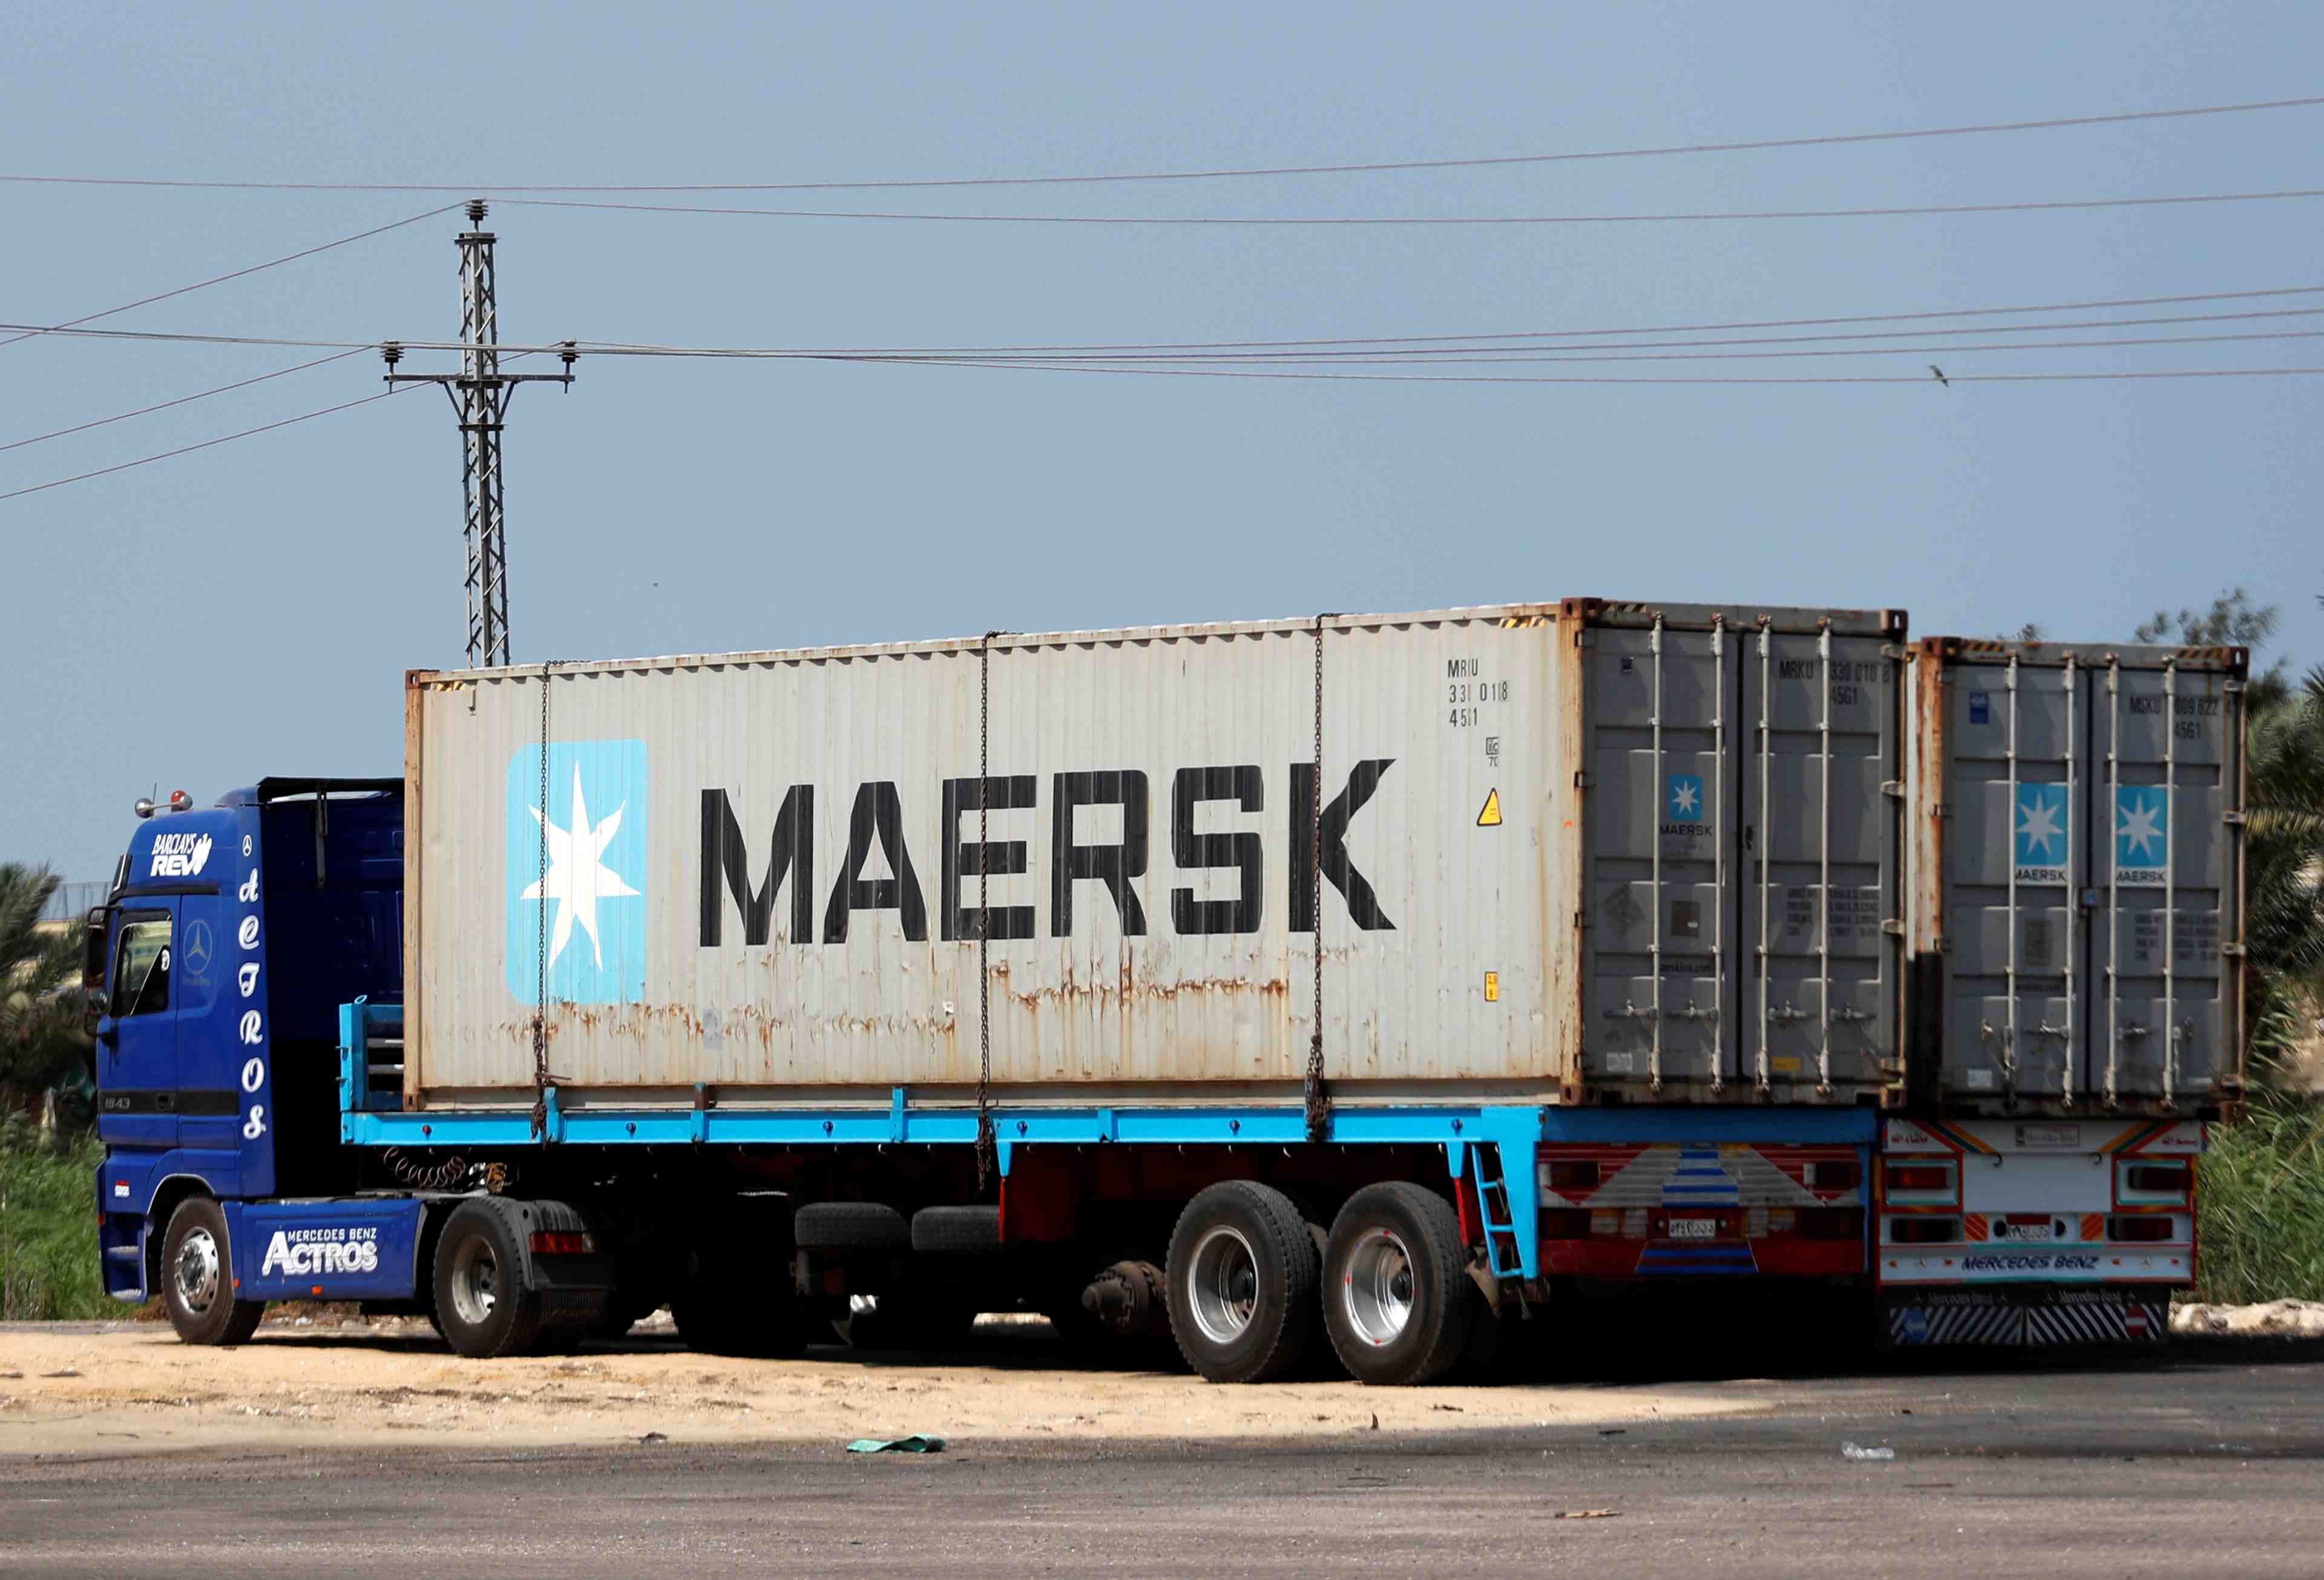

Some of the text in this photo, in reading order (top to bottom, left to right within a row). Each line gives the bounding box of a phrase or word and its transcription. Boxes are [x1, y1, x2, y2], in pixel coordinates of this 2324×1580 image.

[1449, 684, 1471, 703] 33
[1449, 708, 1477, 727] 451
[151, 833, 197, 855] BARCLAYS
[700, 758, 1397, 946] MAERSK
[105, 1097, 131, 1109] 1843
[287, 1227, 377, 1242] MERCEDES BENZ
[261, 1230, 378, 1276] ACTROS
[2054, 1254, 2100, 1270] BENZ
